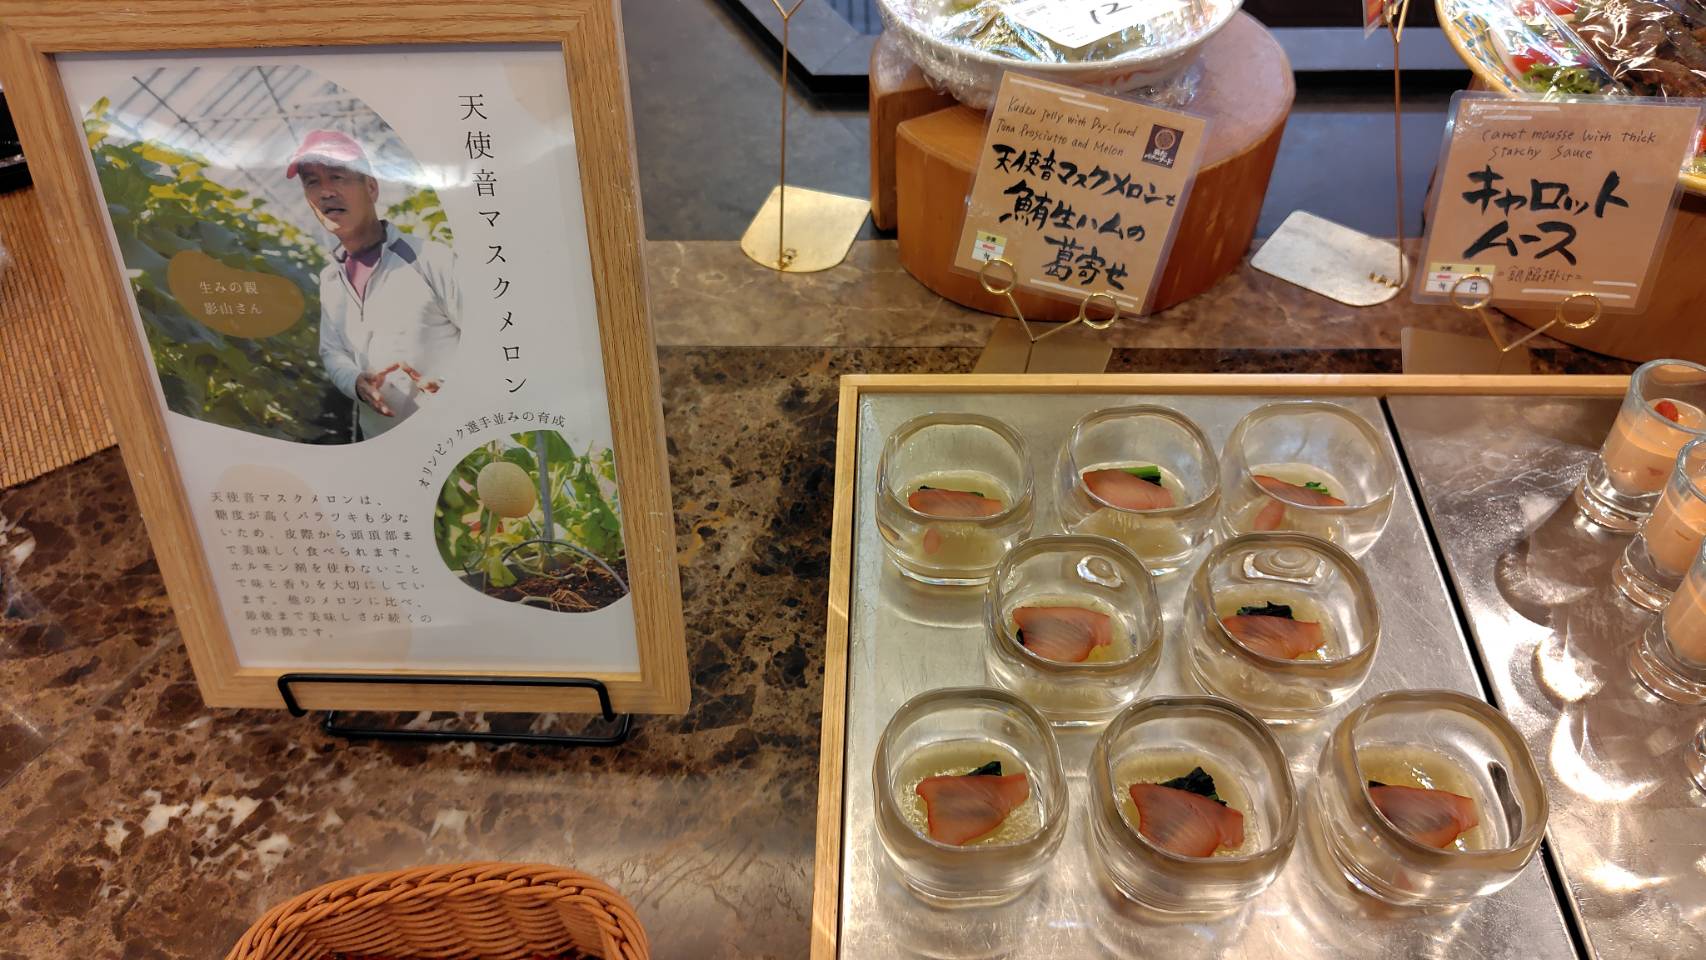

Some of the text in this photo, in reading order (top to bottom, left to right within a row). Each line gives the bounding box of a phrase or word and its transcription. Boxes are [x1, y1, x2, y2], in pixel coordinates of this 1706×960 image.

[1067, 113, 1087, 127] with
[1531, 129, 1575, 142] mousse
[1071, 136, 1090, 151] and
[1092, 141, 1125, 157] Melon
[992, 143, 1176, 207] 天使音マスクメロンと
[1462, 164, 1630, 219] キャロット
[998, 179, 1146, 242] 鮪生ハムの
[458, 93, 527, 393] 天使音マスクメロン
[1041, 235, 1129, 290] 葛寄せ
[1462, 220, 1578, 266] ムース
[199, 280, 259, 295] 生みの親
[203, 301, 263, 316] 影山さん
[417, 410, 567, 489] オリンピック選手並みの育成
